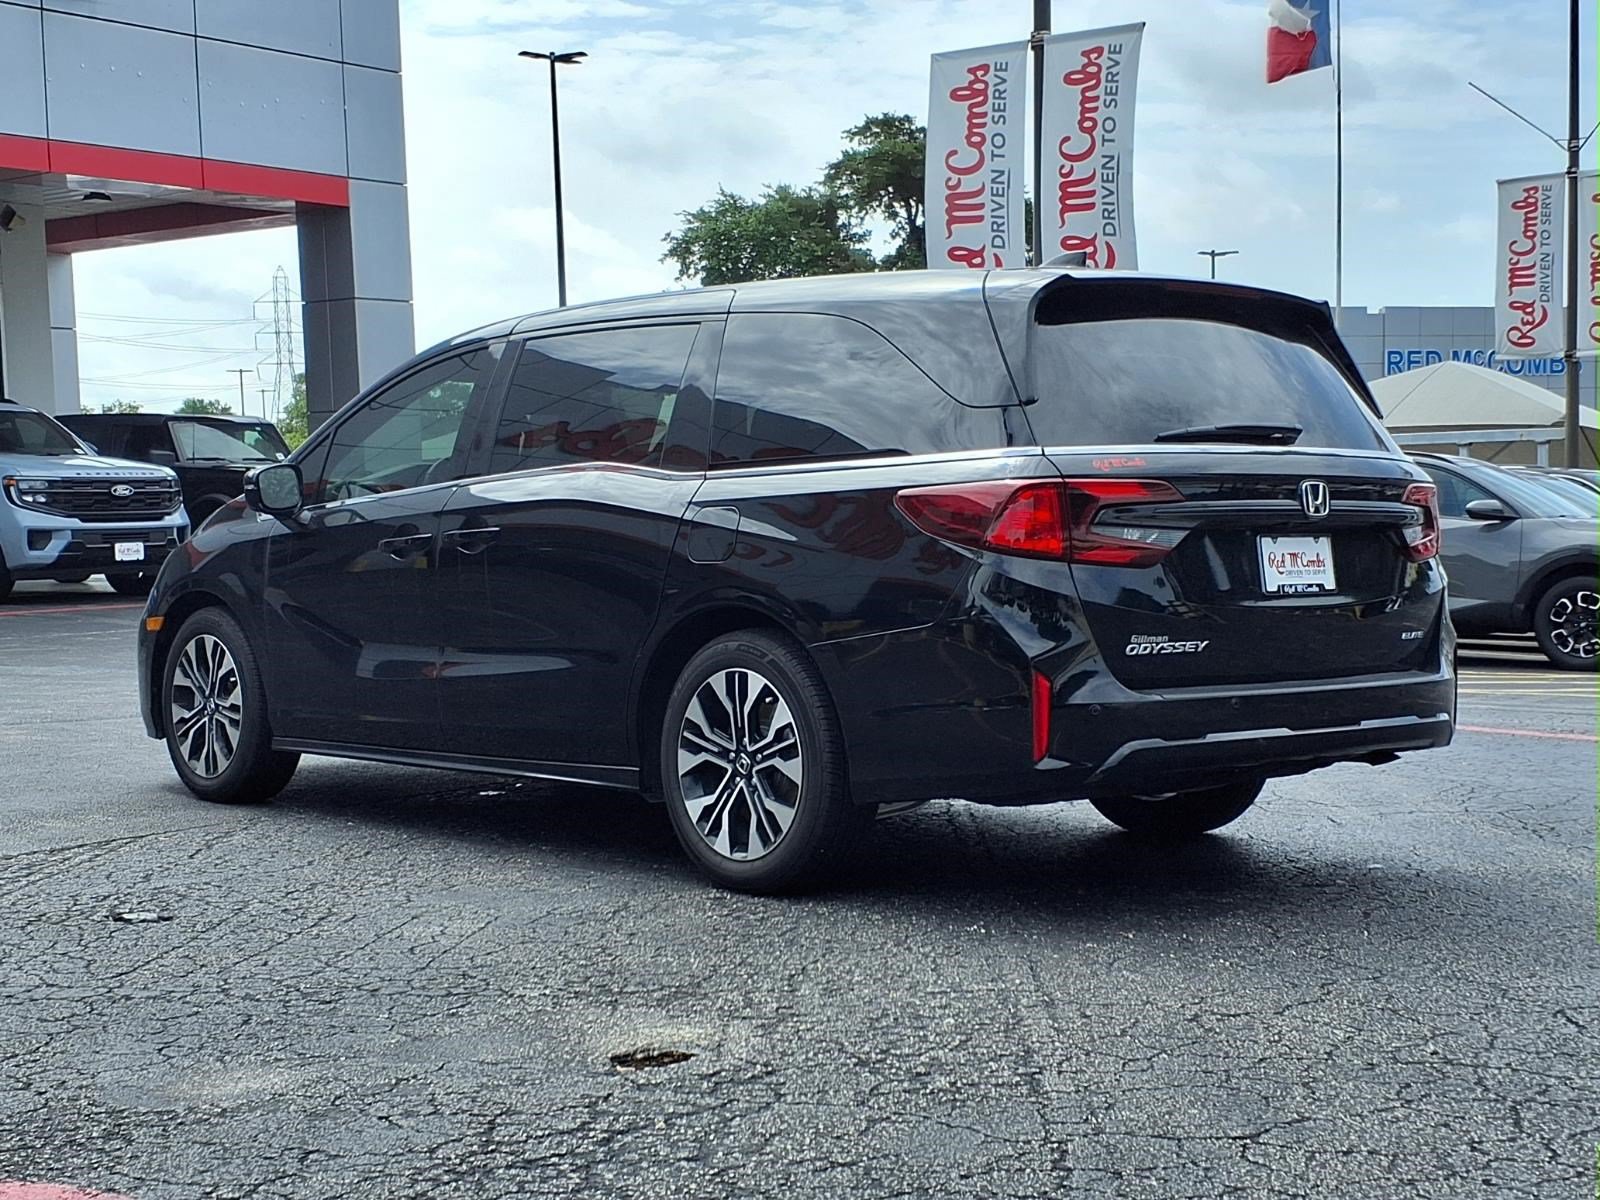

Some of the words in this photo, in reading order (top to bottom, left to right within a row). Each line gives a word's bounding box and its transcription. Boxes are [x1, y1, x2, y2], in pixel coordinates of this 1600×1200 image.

[992, 61, 1008, 125] SERVE
[1104, 43, 1122, 109] SERVE
[991, 133, 1006, 161] TO
[1102, 120, 1117, 146] TO
[991, 169, 1007, 249] DRIVEN
[1102, 154, 1117, 237] DRIVEN
[1541, 184, 1552, 225] SERVE
[1540, 229, 1551, 248] TO
[1539, 252, 1551, 302] DRIVEN
[1506, 299, 1548, 348] Red
[1268, 552, 1286, 575] Red
[1125, 640, 1210, 656] ODYSSEY
[1130, 634, 1169, 644] Gillman
